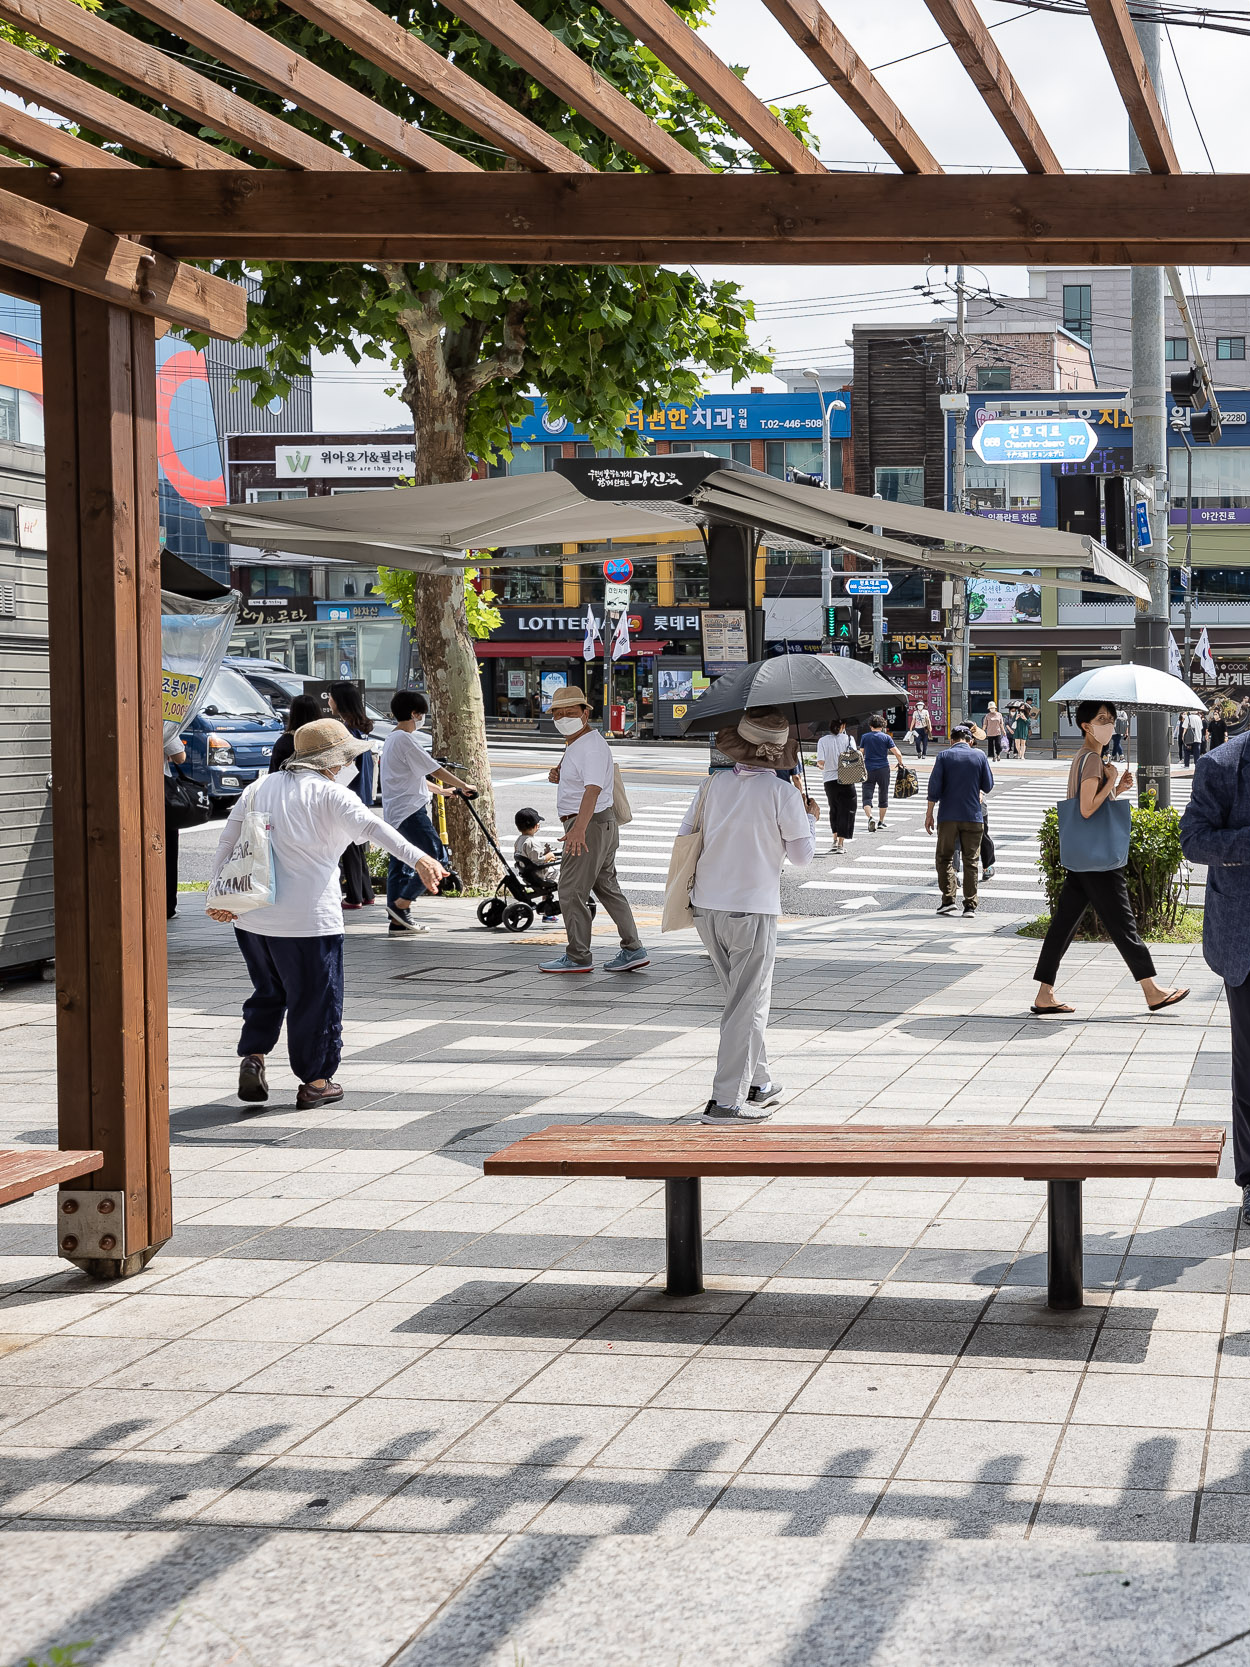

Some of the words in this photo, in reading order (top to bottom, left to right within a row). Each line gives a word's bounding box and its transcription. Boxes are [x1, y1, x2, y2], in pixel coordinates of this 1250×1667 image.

[1008, 424, 1062, 437] 천호대로
[1068, 435, 1086, 446] 672
[631, 470, 666, 487] 광진
[1021, 513, 1038, 522] 전문
[1201, 511, 1236, 522] 야간진료
[980, 585, 1002, 594] 신선한
[1004, 585, 1019, 593] 요리
[352, 607, 379, 616] 아차산
[653, 615, 700, 631] 롯데리
[931, 683, 943, 722] 노래방
